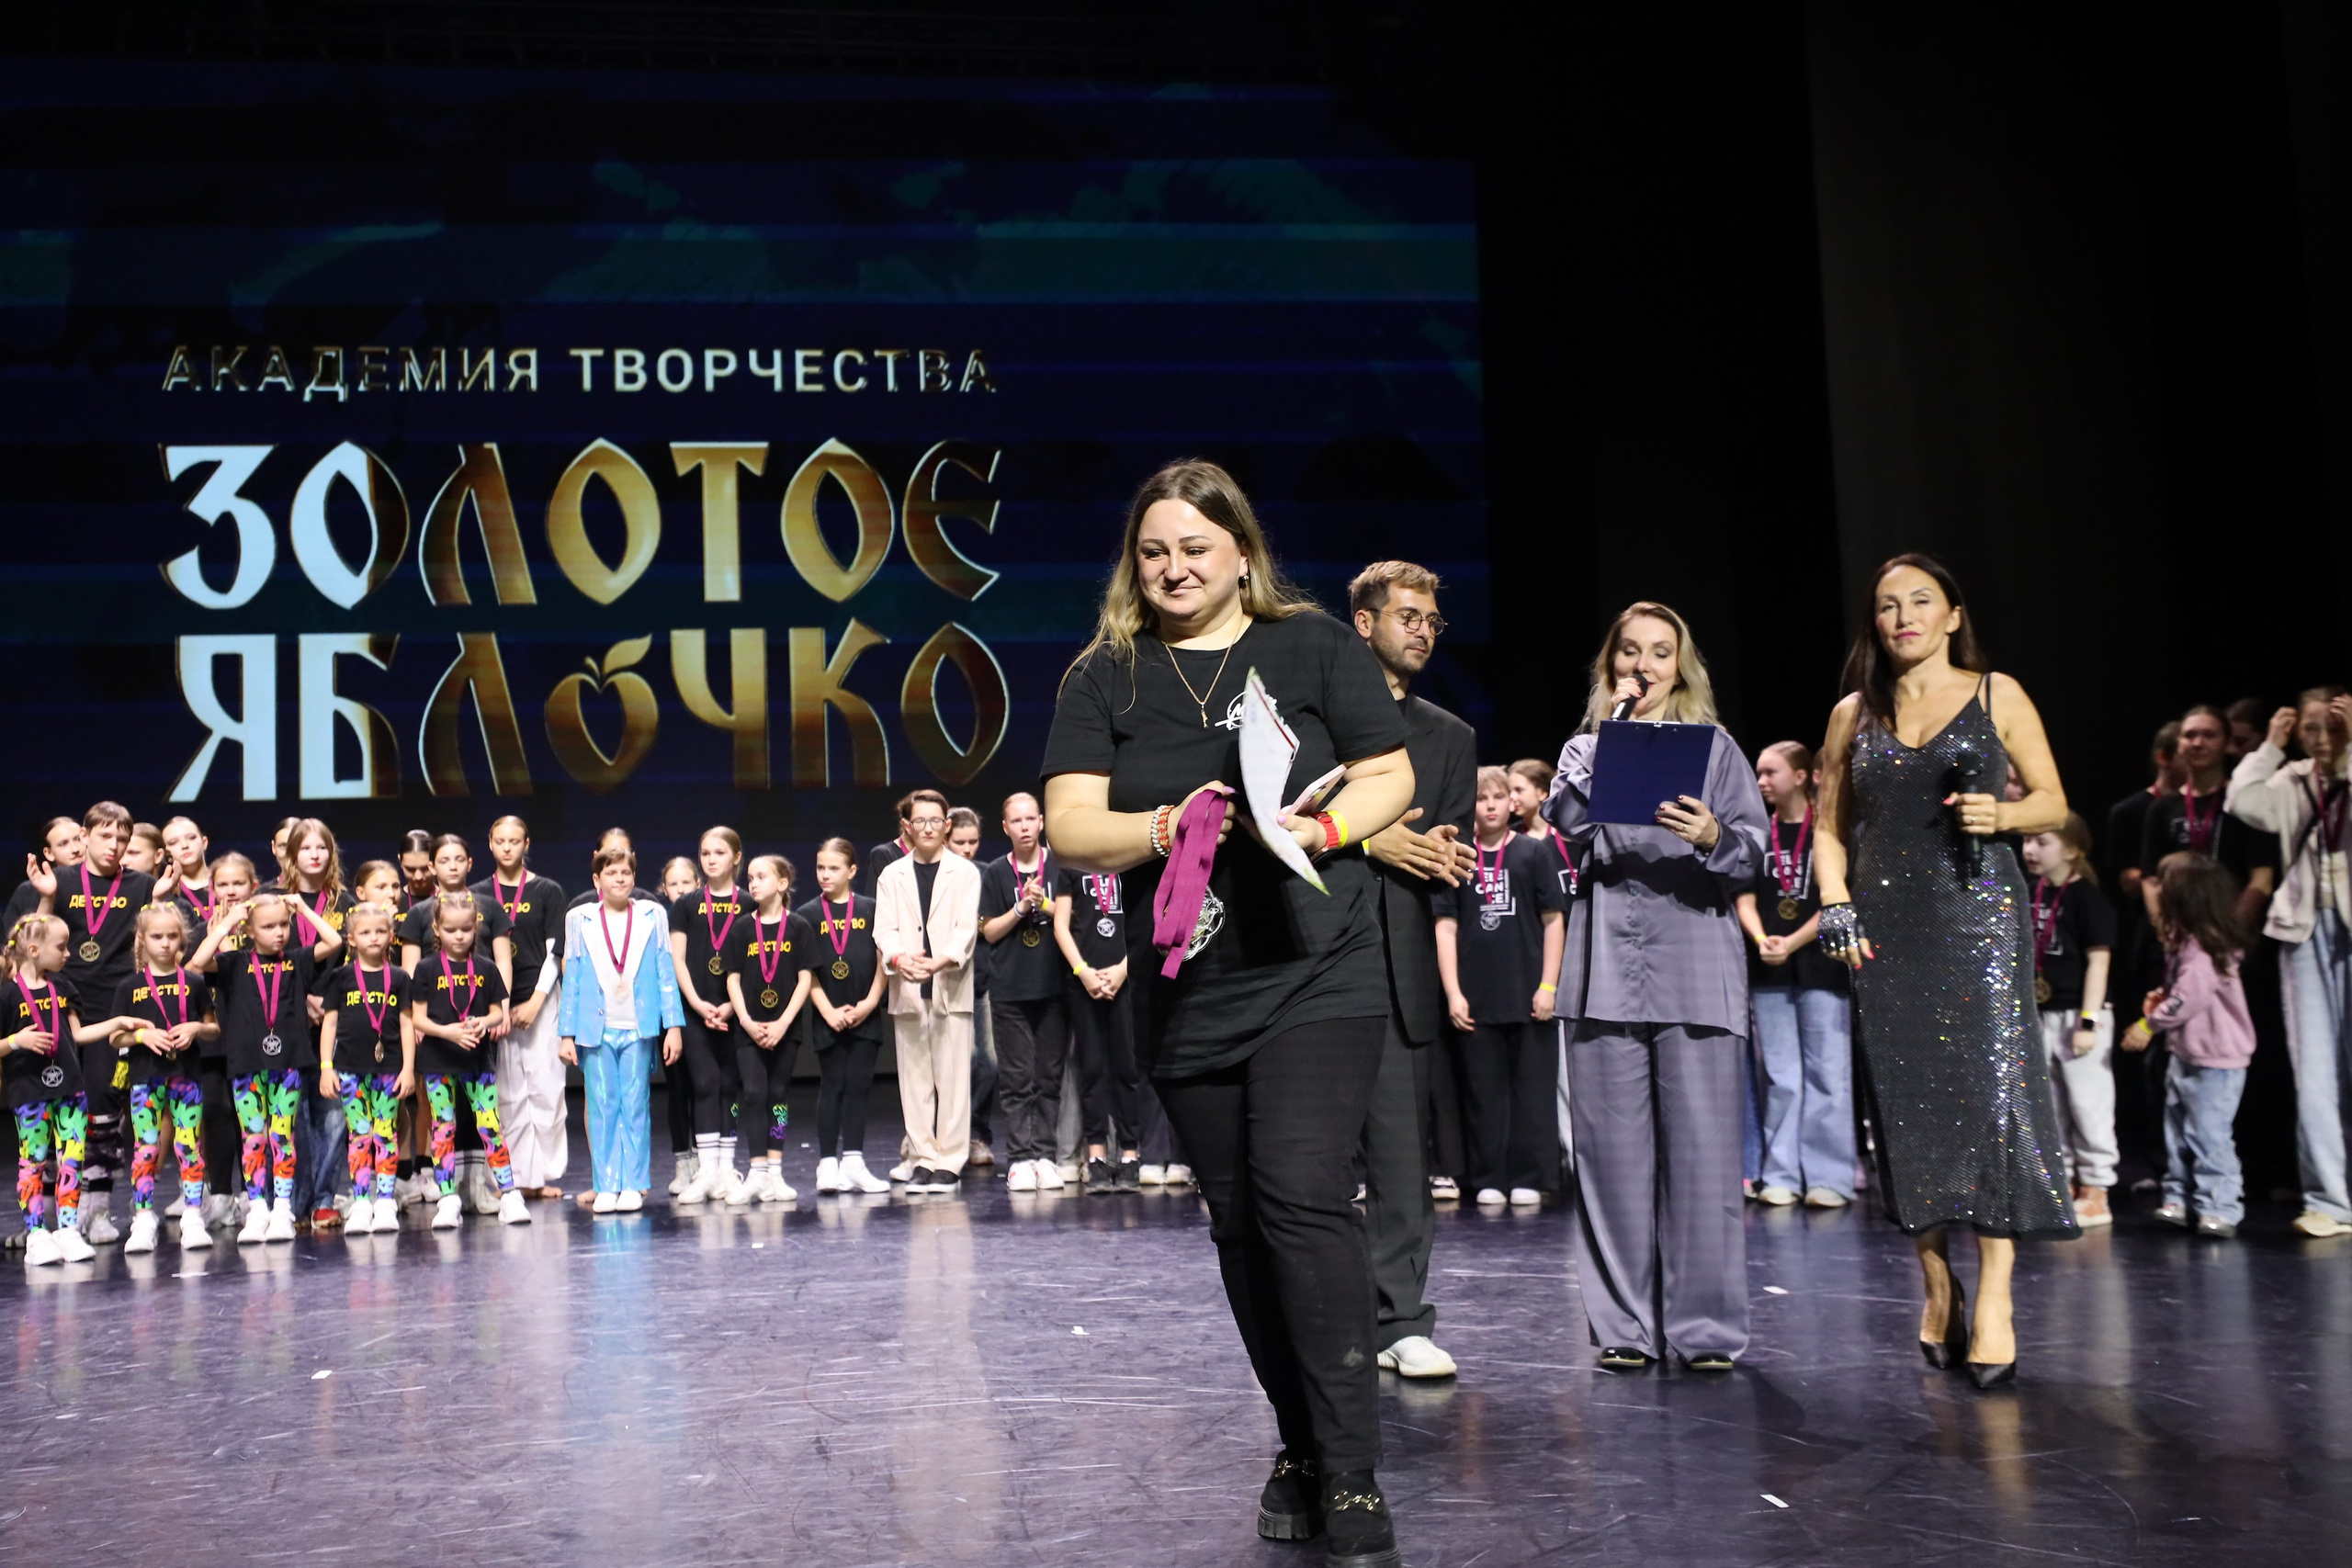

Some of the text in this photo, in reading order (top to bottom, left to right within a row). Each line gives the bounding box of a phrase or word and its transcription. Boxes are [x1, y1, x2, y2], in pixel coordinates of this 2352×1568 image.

[161, 345, 998, 402] АКАДЕМИЯ ТВОРЧЕСТВА
[165, 615, 1011, 803] ЯБЛОЧКО
